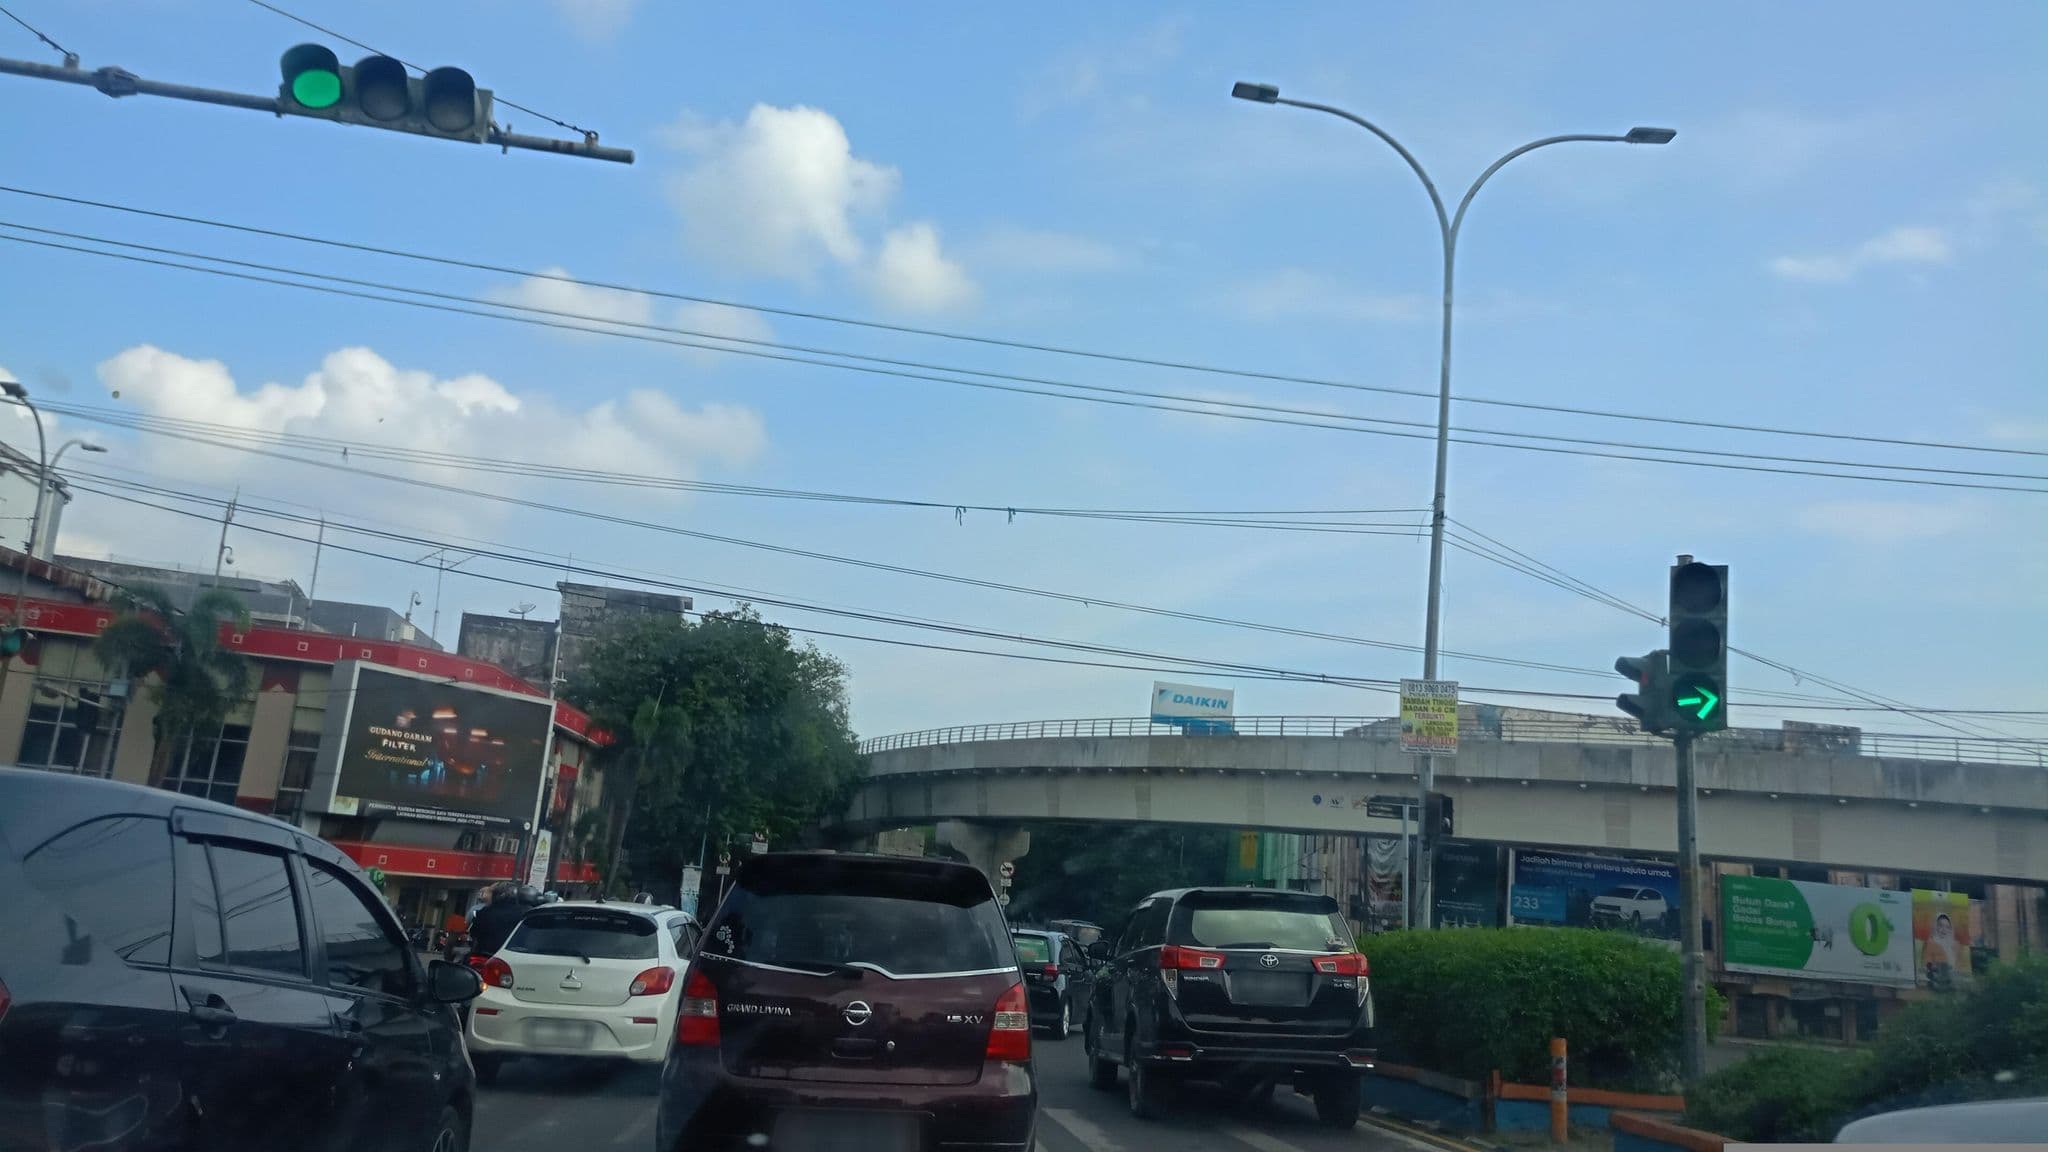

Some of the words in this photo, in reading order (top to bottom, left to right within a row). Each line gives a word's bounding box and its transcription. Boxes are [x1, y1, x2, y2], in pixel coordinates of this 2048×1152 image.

[1172, 693, 1228, 709] DAIKIN
[369, 726, 402, 738] GUDANG
[404, 732, 432, 742] GARAM
[382, 738, 416, 752] FILTER
[365, 750, 428, 767] International
[1520, 854, 1550, 865] Jadilah
[1621, 866, 1647, 877] sejuta
[1648, 869, 1672, 878] umat.
[1514, 896, 1539, 910] 233
[727, 1003, 758, 1014] GRAND
[759, 1006, 792, 1016] LIVINA
[964, 1015, 983, 1025] XV
